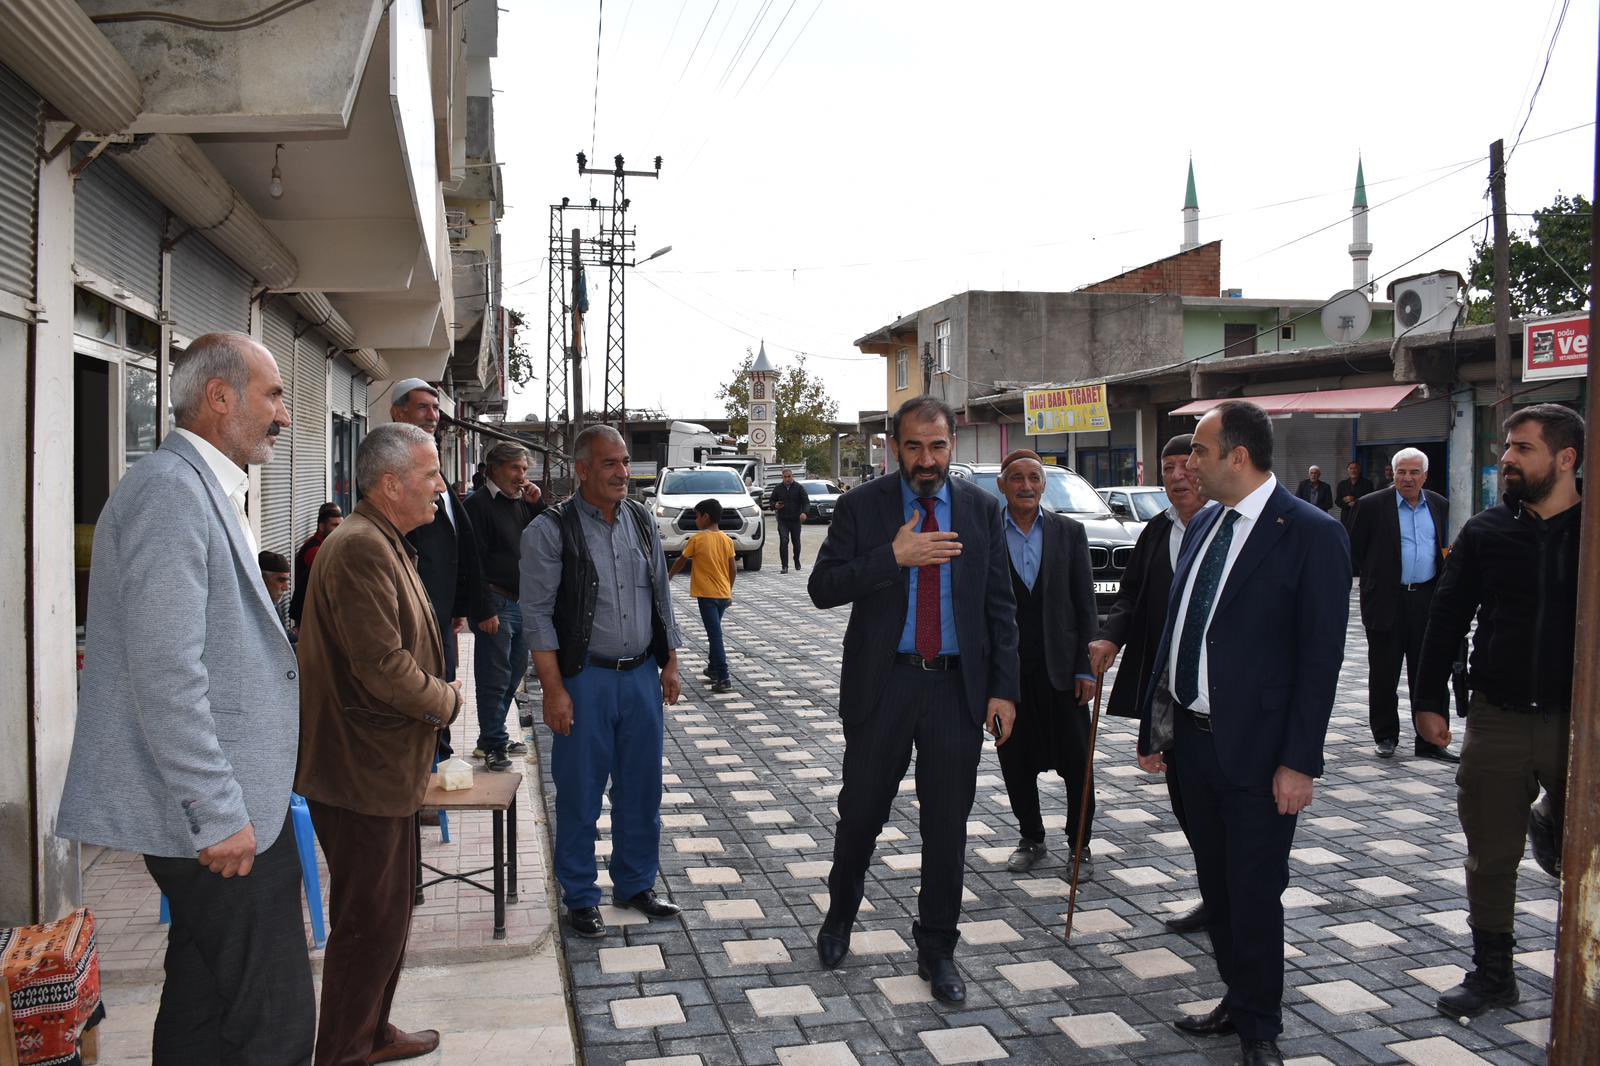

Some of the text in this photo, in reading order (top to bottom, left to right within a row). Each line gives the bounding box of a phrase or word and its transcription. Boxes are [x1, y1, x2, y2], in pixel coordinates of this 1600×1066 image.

[1558, 328, 1575, 337] DOĞU
[1048, 390, 1067, 408] BABA
[1105, 583, 1116, 592] LA
